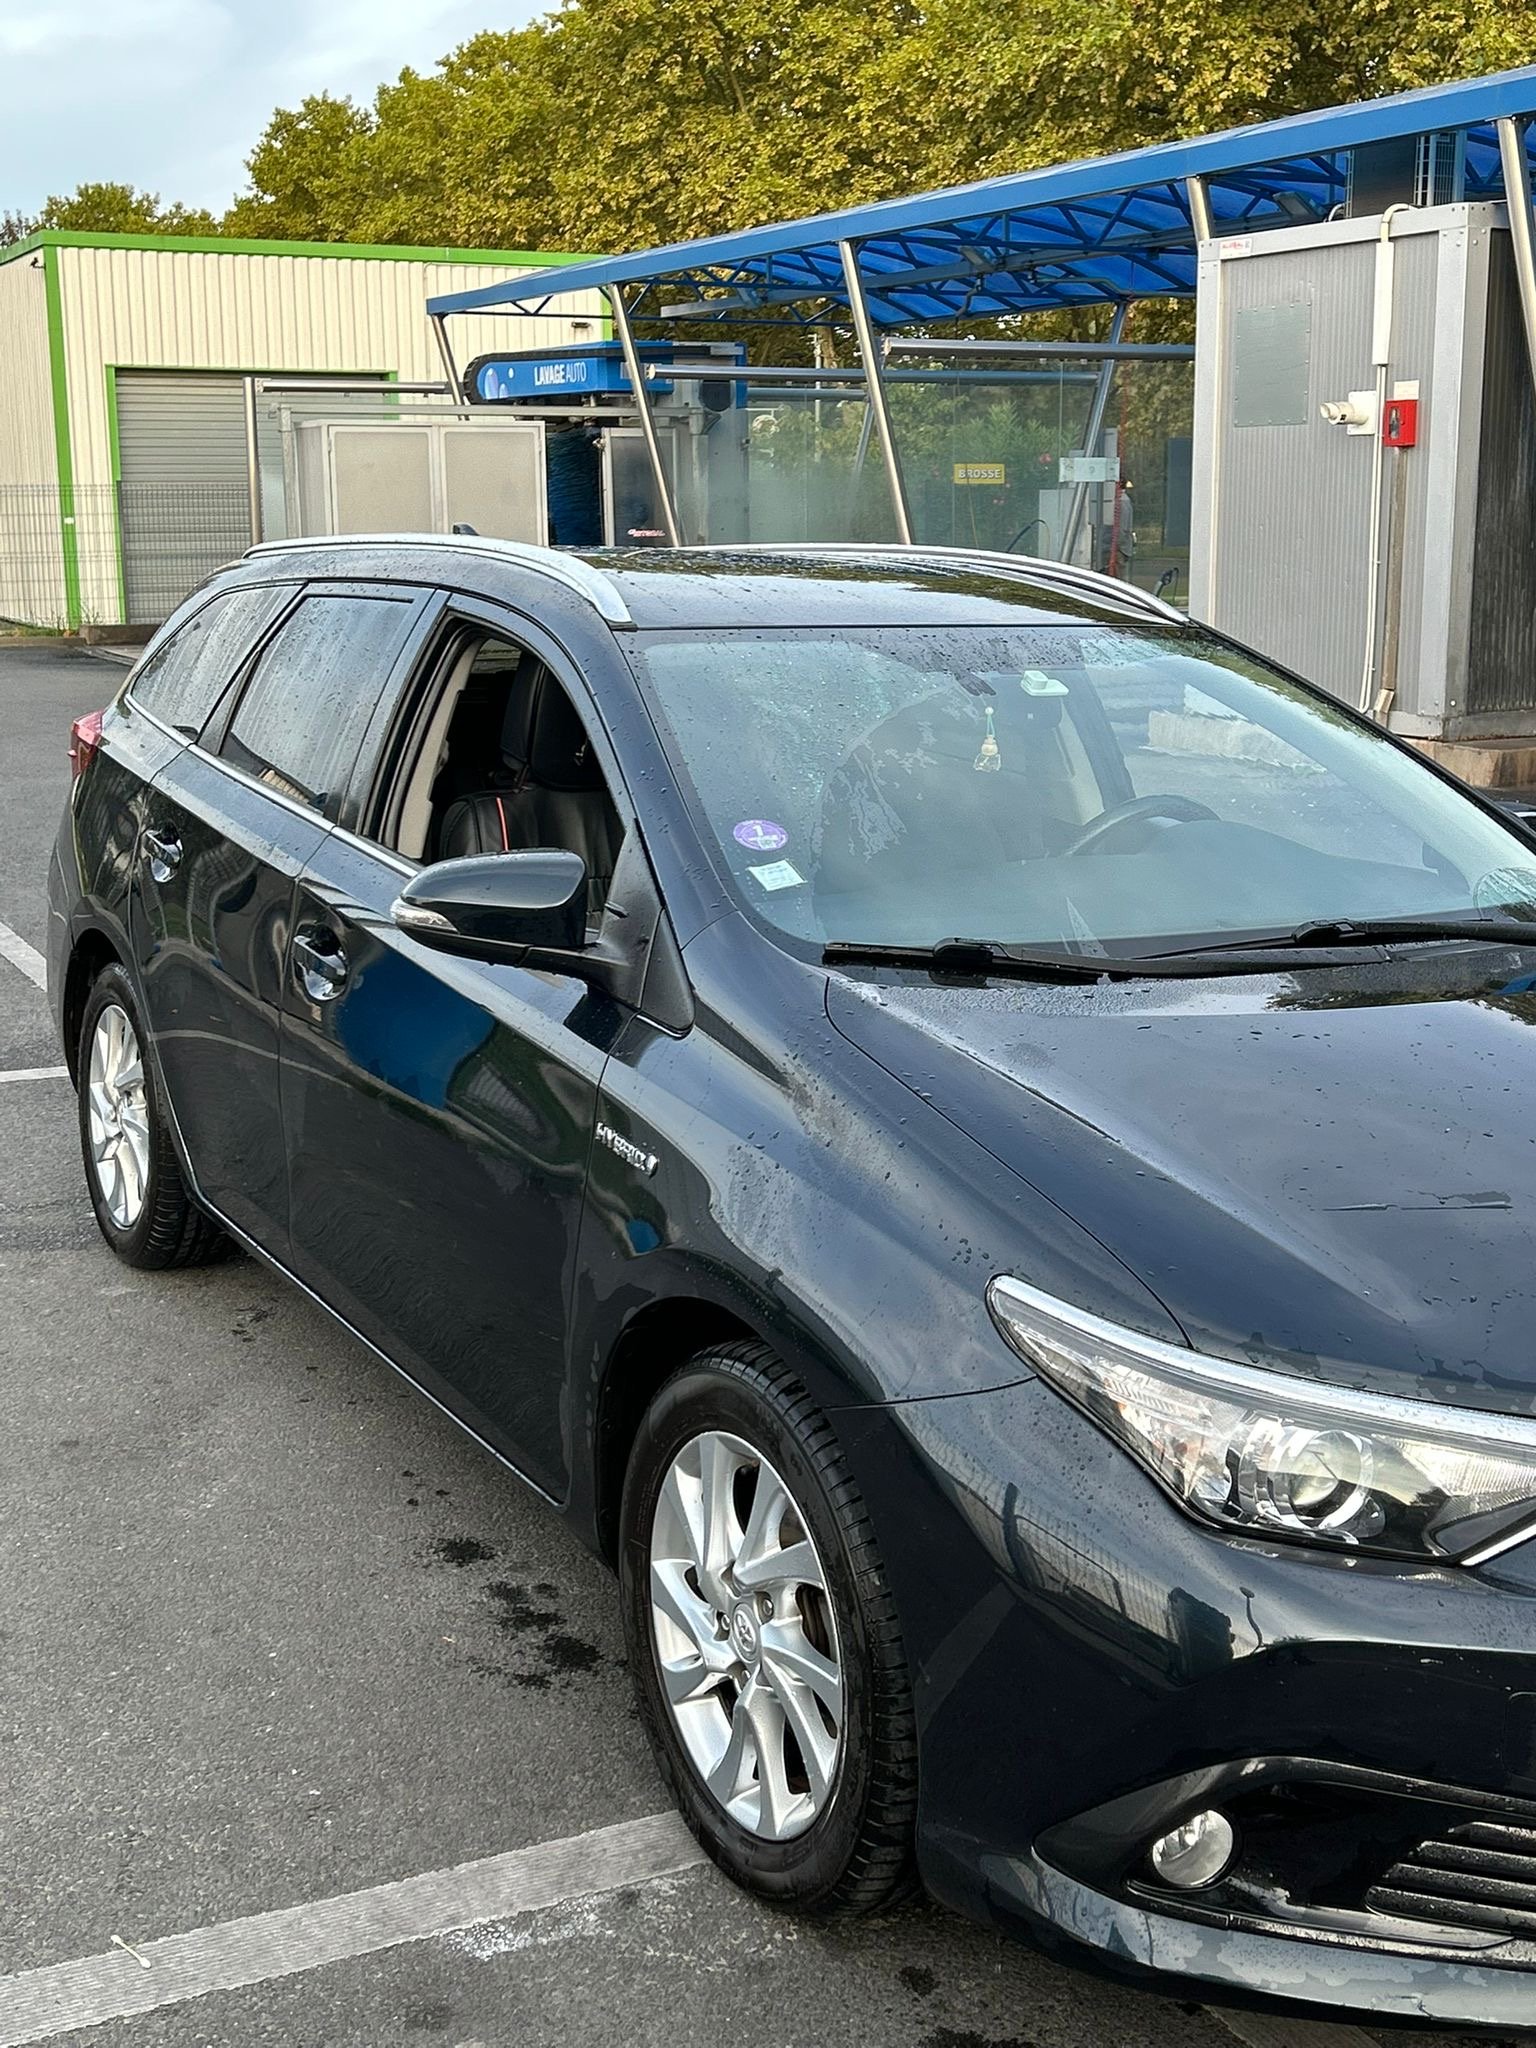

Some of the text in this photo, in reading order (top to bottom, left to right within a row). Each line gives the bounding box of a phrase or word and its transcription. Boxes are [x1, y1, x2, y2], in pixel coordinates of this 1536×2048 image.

[534, 361, 587, 386] LAVAGE AUTO
[958, 469, 1001, 479] BROSSE
